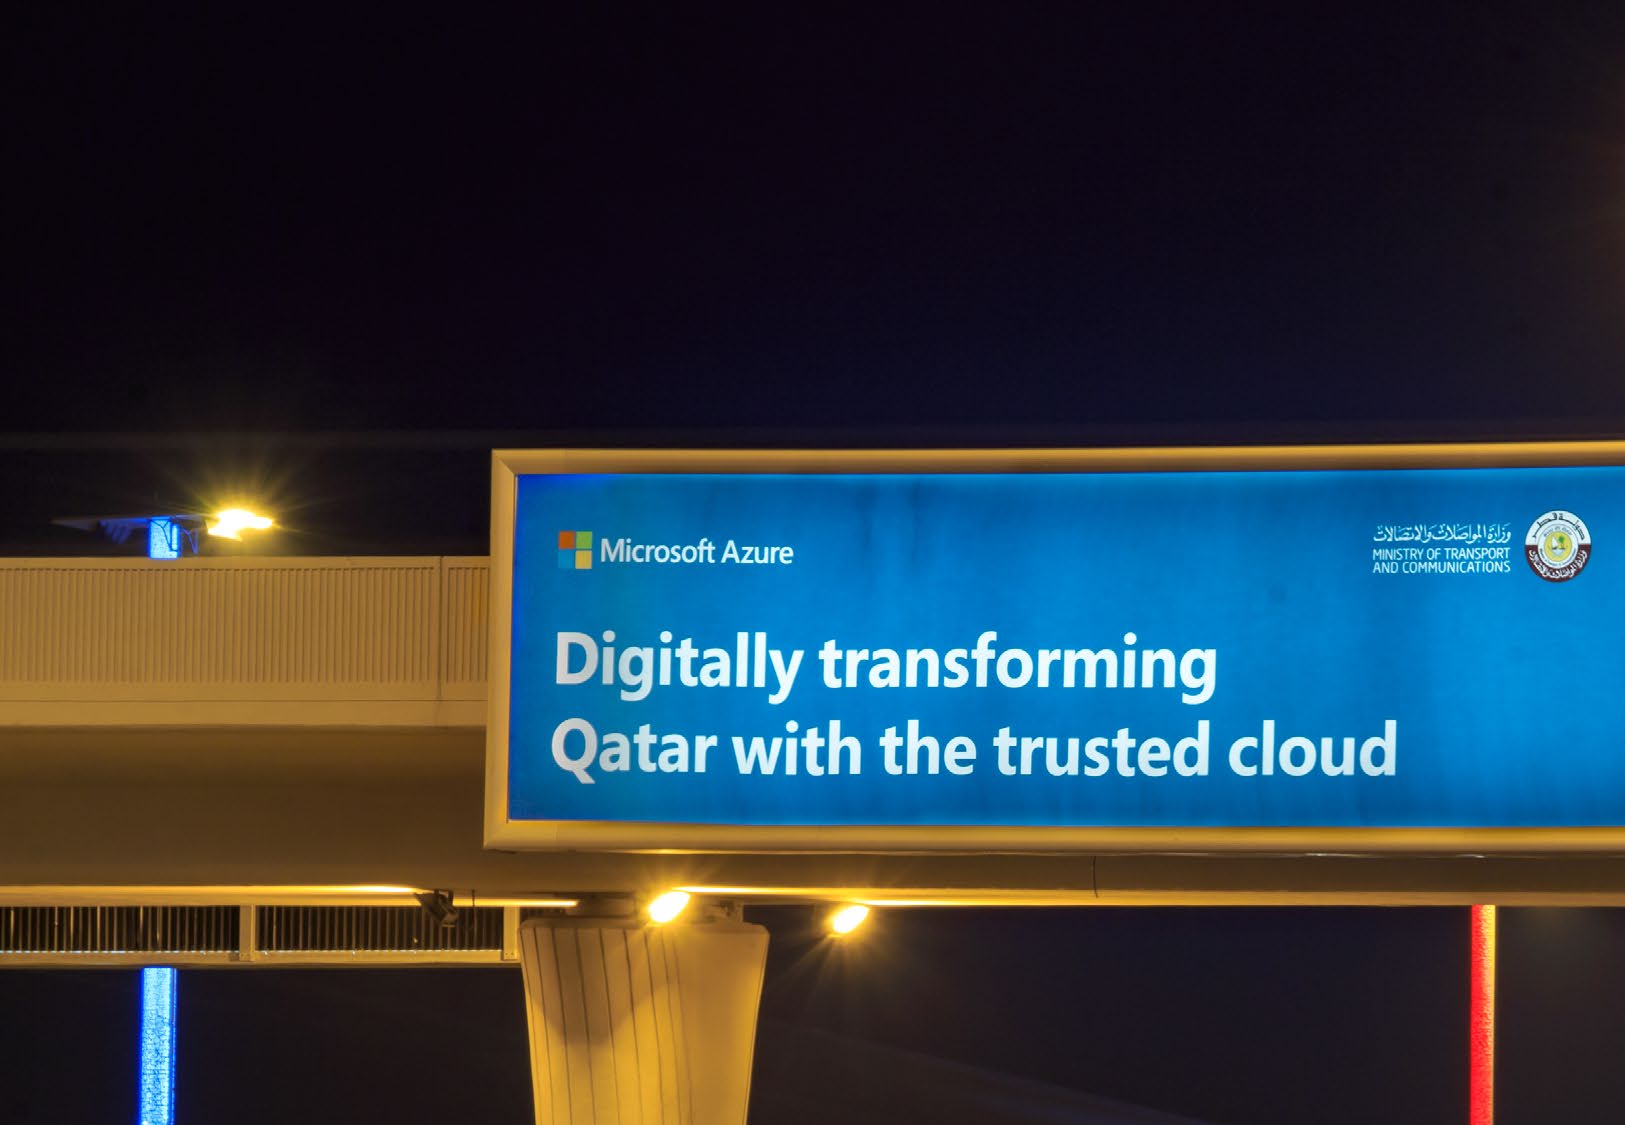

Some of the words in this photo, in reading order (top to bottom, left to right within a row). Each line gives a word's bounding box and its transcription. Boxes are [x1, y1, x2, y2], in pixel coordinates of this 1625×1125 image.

[1373, 524, 1432, 543] والاتصالات
[1432, 523, 1487, 544] المواصلات
[1487, 522, 1512, 544] وزارة
[601, 538, 716, 564] Microsoft
[721, 540, 794, 564] Azure
[1372, 548, 1424, 560] MINISTRY
[1426, 548, 1441, 560] OF
[1443, 547, 1511, 560] TRANSPORT
[1372, 561, 1399, 573] AND
[1402, 560, 1511, 573] COMMUNICATIONS
[556, 630, 804, 705] Digitally
[818, 631, 1217, 705] transforming
[551, 717, 718, 784] Qatar
[731, 719, 862, 776] with
[880, 719, 977, 776] the
[993, 719, 1210, 777] trusted
[1228, 719, 1397, 777] cloud
